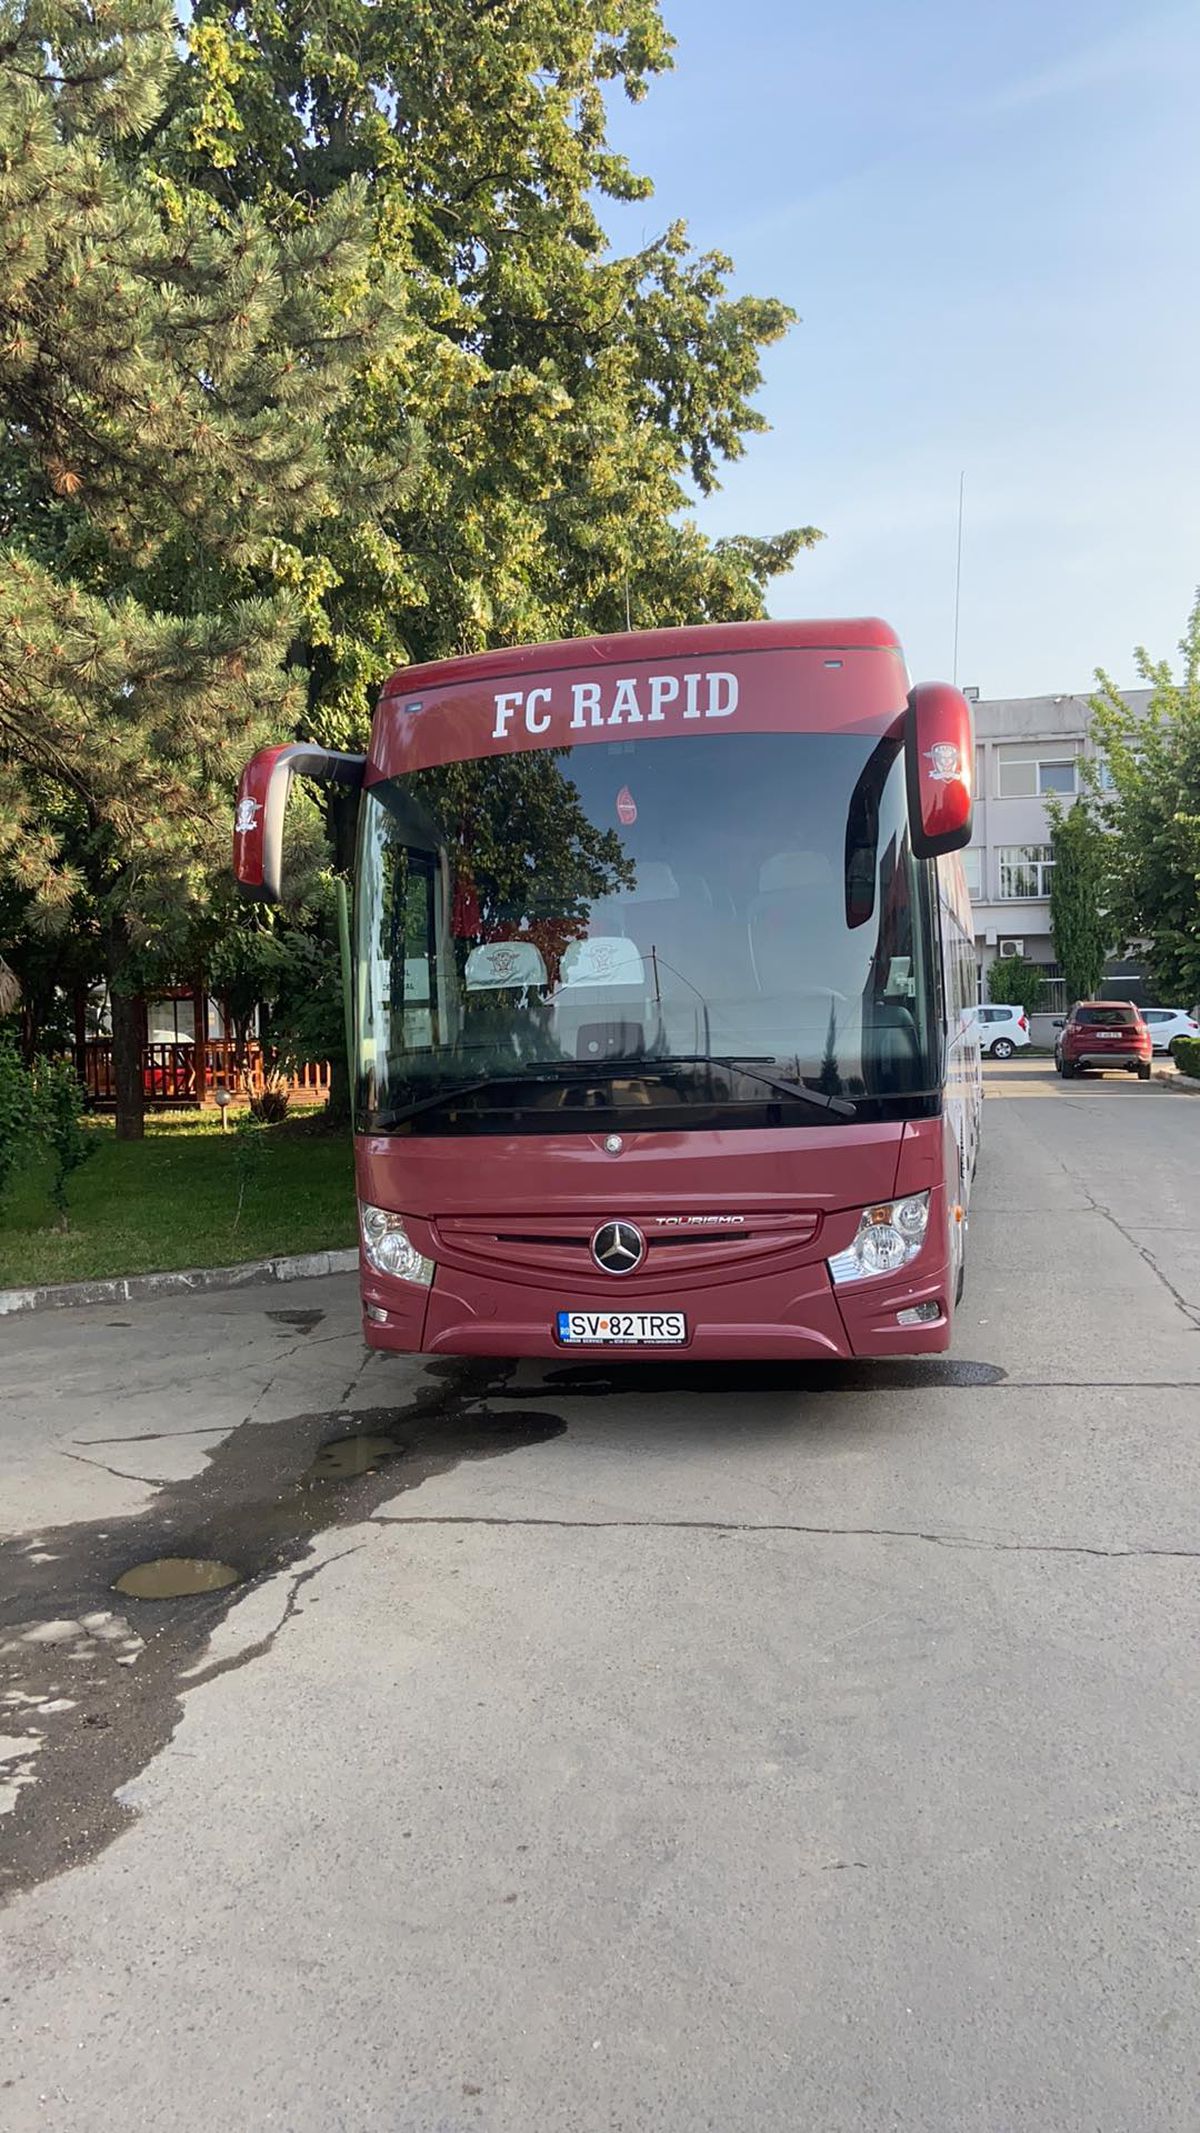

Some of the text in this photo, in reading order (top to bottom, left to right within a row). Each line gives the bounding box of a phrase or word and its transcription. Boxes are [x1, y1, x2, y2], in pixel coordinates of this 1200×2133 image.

[492, 672, 739, 738] FC RAPID
[655, 1216, 745, 1226] TOURISMO
[571, 1316, 600, 1336] SV
